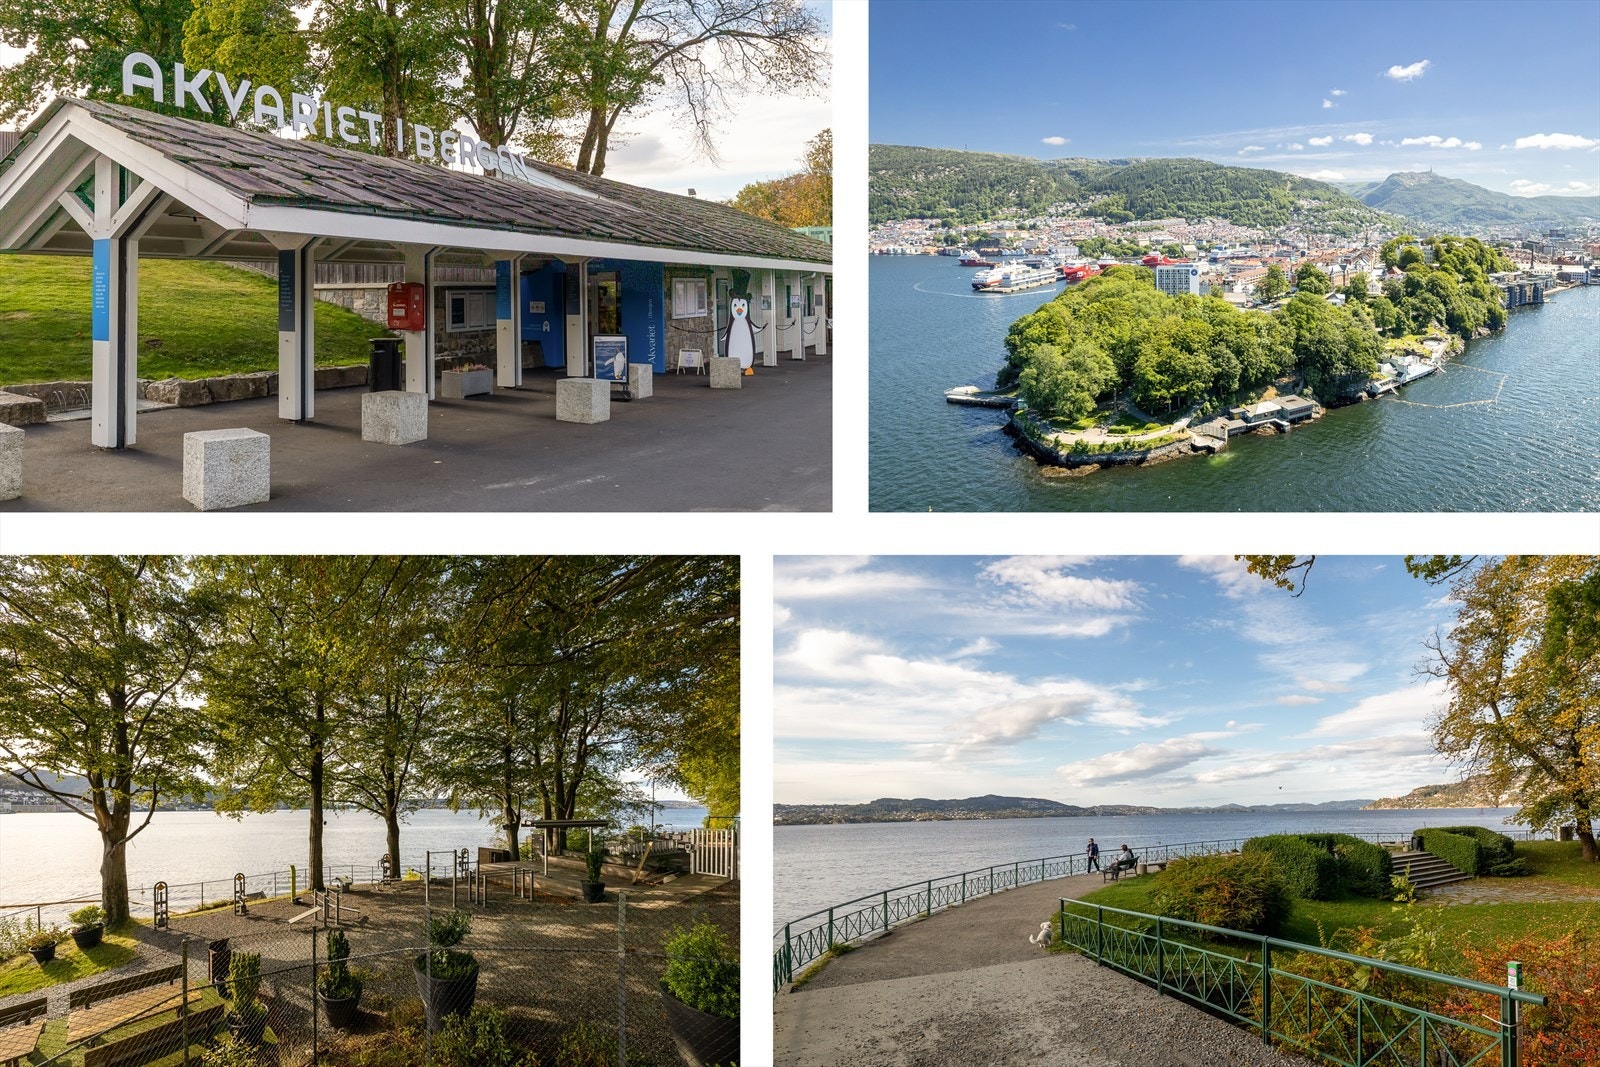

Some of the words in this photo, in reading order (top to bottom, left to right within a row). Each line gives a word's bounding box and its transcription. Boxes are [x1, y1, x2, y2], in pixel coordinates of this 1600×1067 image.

[122, 52, 382, 147] AKVARIET
[397, 118, 404, 152] I
[414, 124, 529, 180] BERGEN
[647, 324, 656, 364] Akvariet
